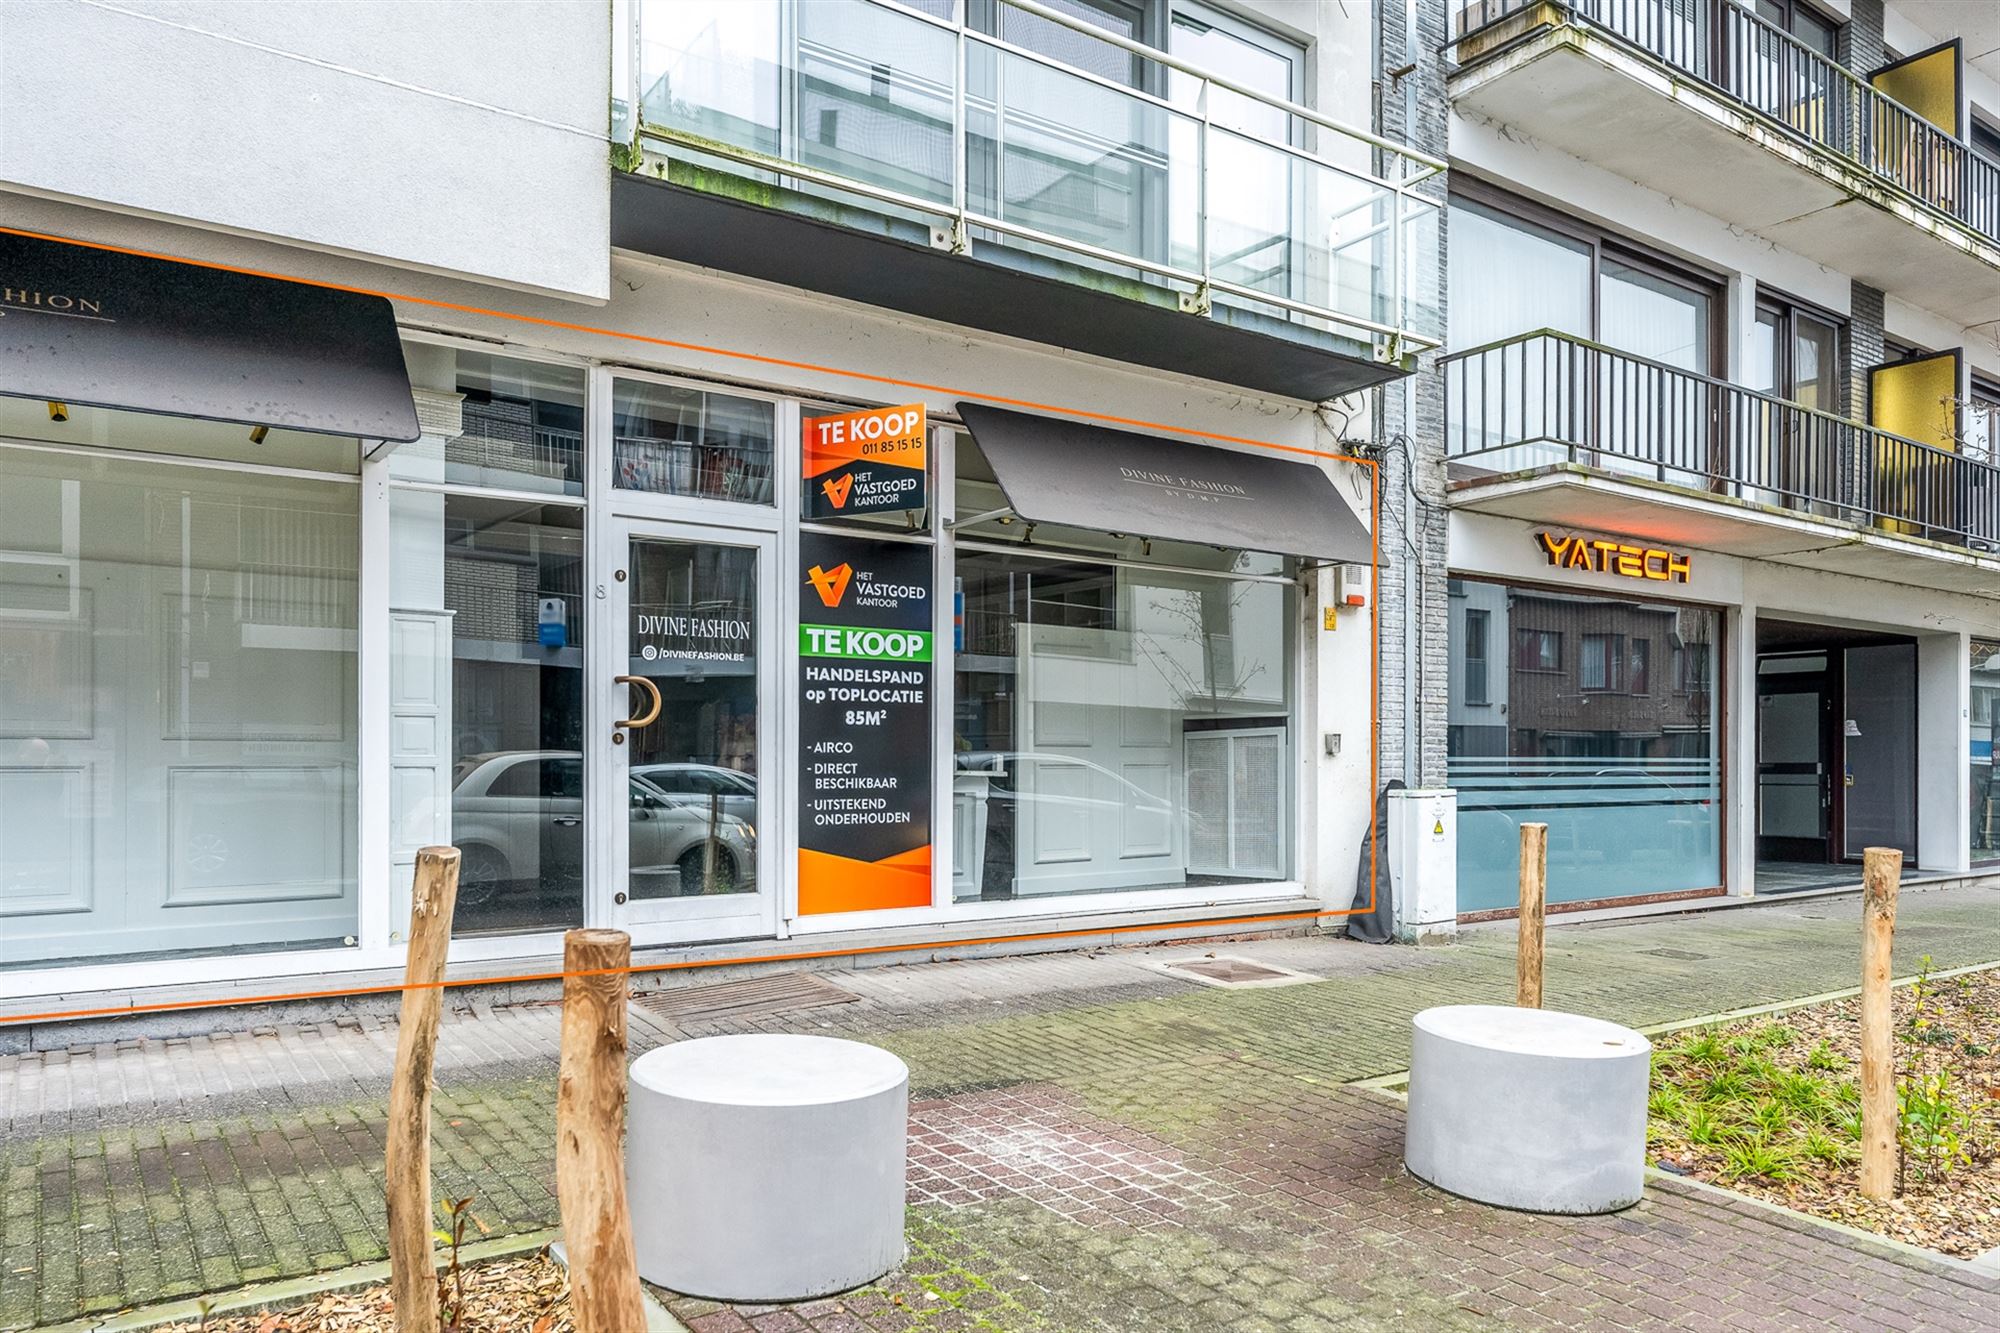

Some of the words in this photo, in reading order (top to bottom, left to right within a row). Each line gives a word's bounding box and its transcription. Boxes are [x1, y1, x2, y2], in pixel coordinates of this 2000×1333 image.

[818, 420, 846, 445] TE
[850, 411, 920, 442] KOOP
[862, 443, 878, 455] 011
[880, 441, 895, 453] 85
[897, 439, 909, 451] 15
[911, 437, 923, 449] 15
[854, 471, 873, 483] HET
[1120, 467, 1176, 485] DIVINE
[1179, 477, 1247, 496] FASHION
[854, 478, 917, 496] VASTGOED
[854, 493, 900, 507] KANTOOR
[1534, 531, 1691, 584] YATECH
[856, 571, 874, 581] HET
[595, 584, 607, 600] 8
[856, 582, 926, 600] VASTGOED
[856, 597, 898, 609] KANTOOR
[638, 614, 689, 637] DIVINE
[691, 618, 751, 640] FASHION
[806, 628, 842, 654] TE
[846, 630, 924, 658] KOOP
[658, 647, 745, 662] /DIVINEFASHION.BE
[806, 667, 924, 685] HANDELSPAND
[805, 690, 826, 704] op
[828, 687, 924, 703] TOPLOCATIE
[813, 741, 854, 754] AIRCO
[814, 763, 858, 775] DIRECT
[815, 777, 897, 790] BESCHIKBAAR
[814, 798, 887, 811] UITSTEKEND
[814, 811, 911, 826] ONDERHOUDEN
